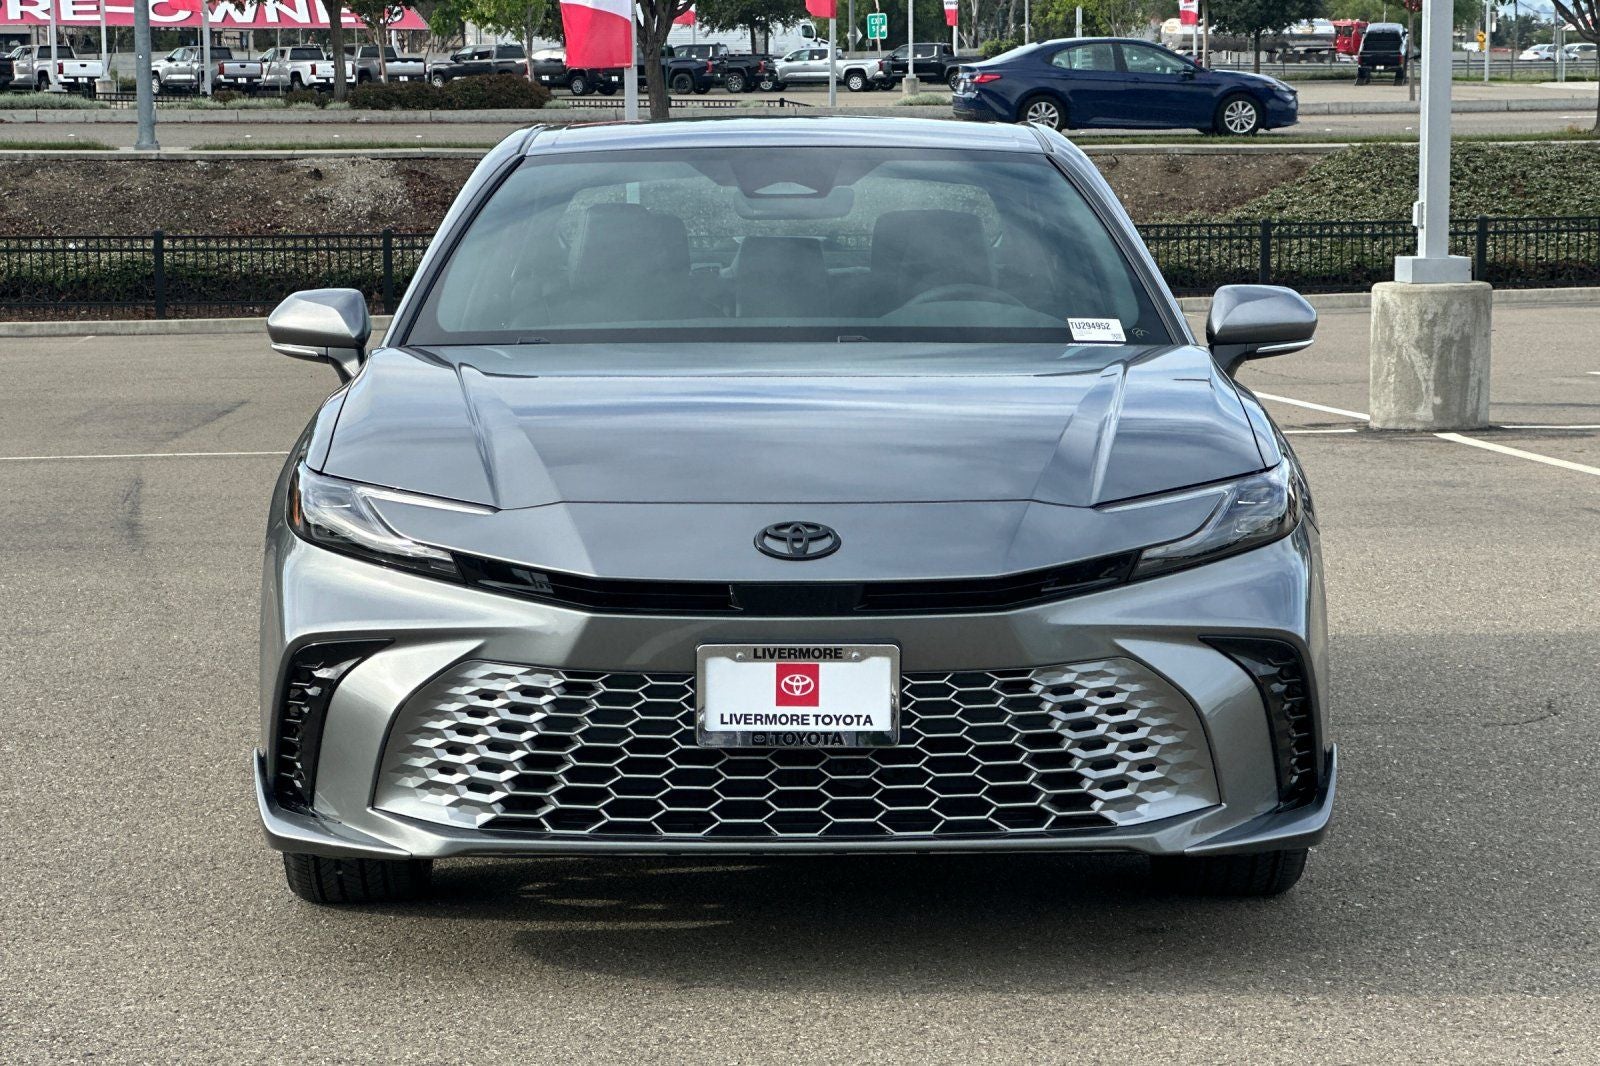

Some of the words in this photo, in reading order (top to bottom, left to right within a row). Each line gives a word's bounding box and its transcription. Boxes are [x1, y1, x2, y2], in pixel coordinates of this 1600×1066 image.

[1069, 321, 1111, 330] TU294952
[753, 647, 843, 659] LIVERMORE
[720, 713, 810, 725] LIVERMORE
[813, 714, 874, 726] TOYOTA
[772, 731, 844, 746] TOYOTA
